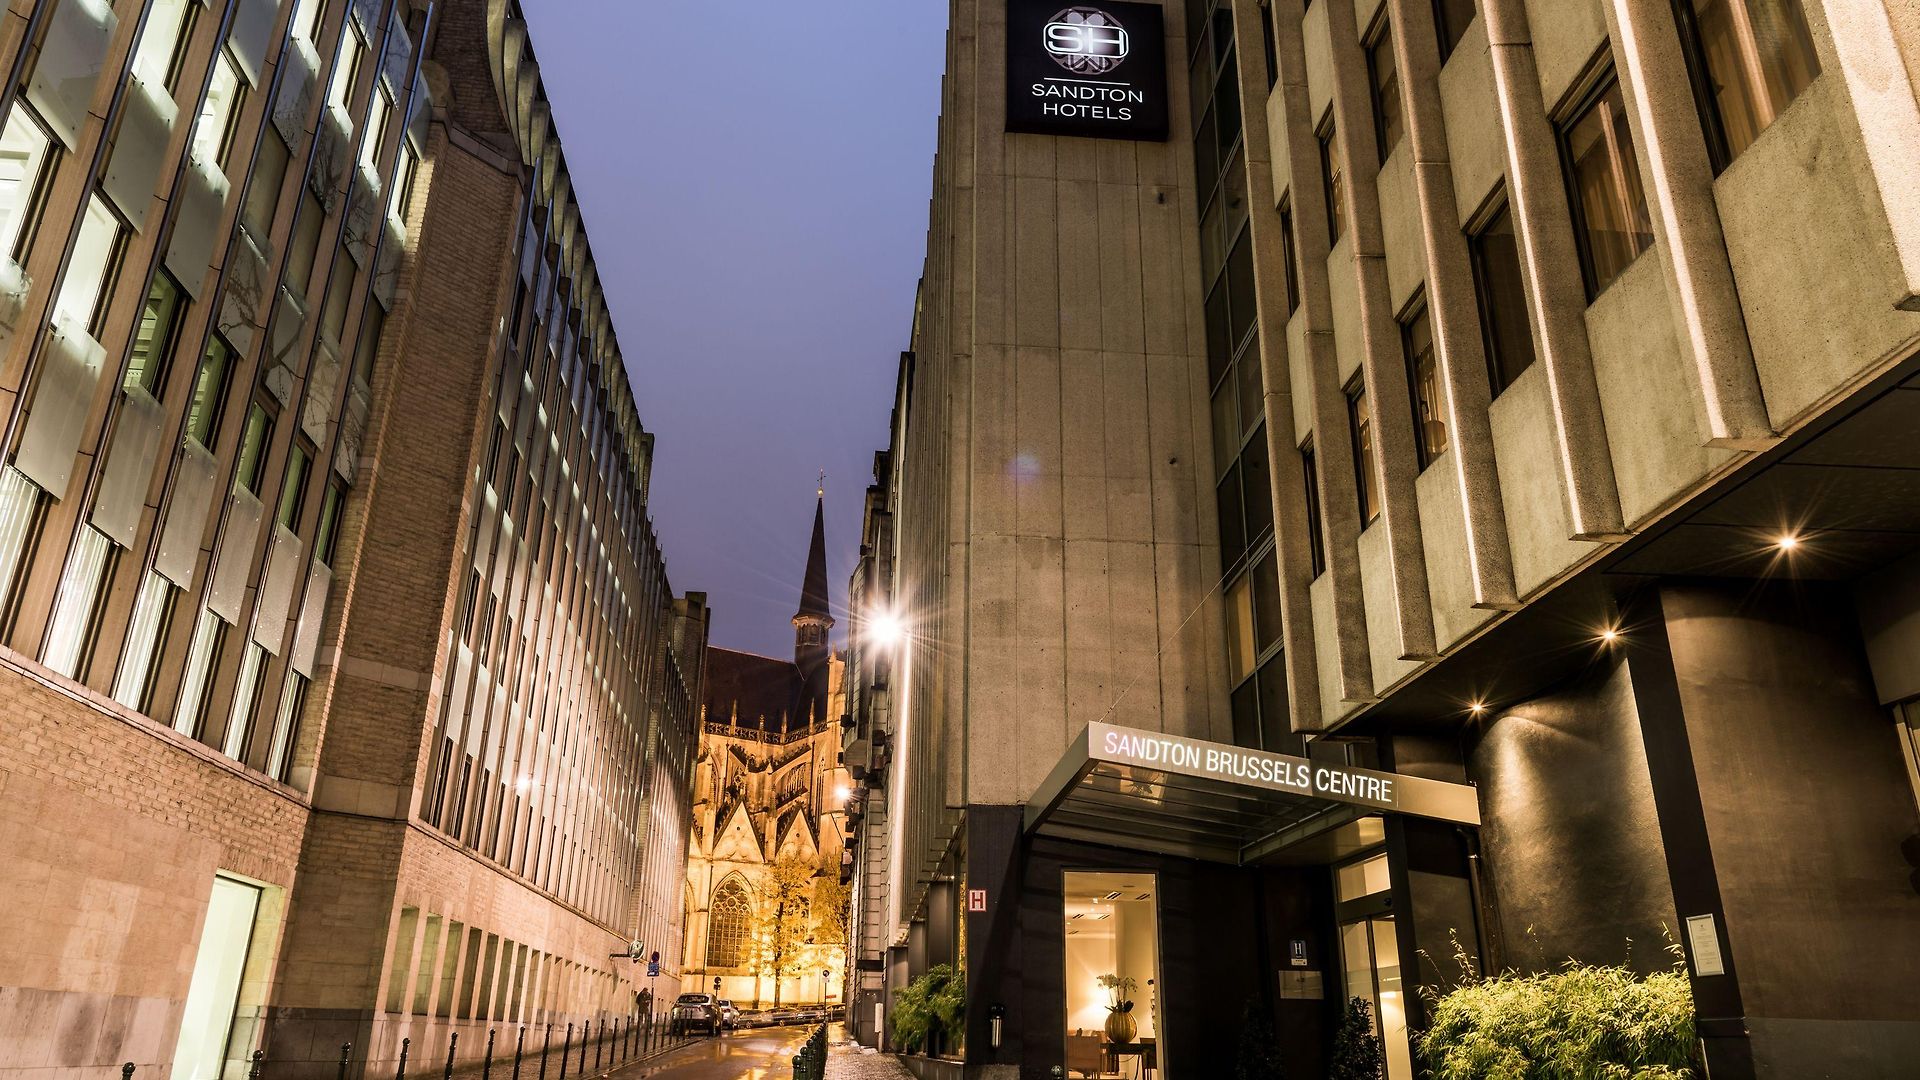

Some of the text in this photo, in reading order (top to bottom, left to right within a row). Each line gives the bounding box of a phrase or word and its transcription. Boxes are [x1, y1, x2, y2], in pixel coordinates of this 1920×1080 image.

[1047, 25, 1124, 55] SH
[1031, 83, 1143, 103] SANDTON
[1043, 102, 1132, 121] HOTELS
[1104, 732, 1393, 802] SANDTON BRUSSELS CENTRE
[971, 891, 984, 909] H
[1294, 942, 1302, 955] H
